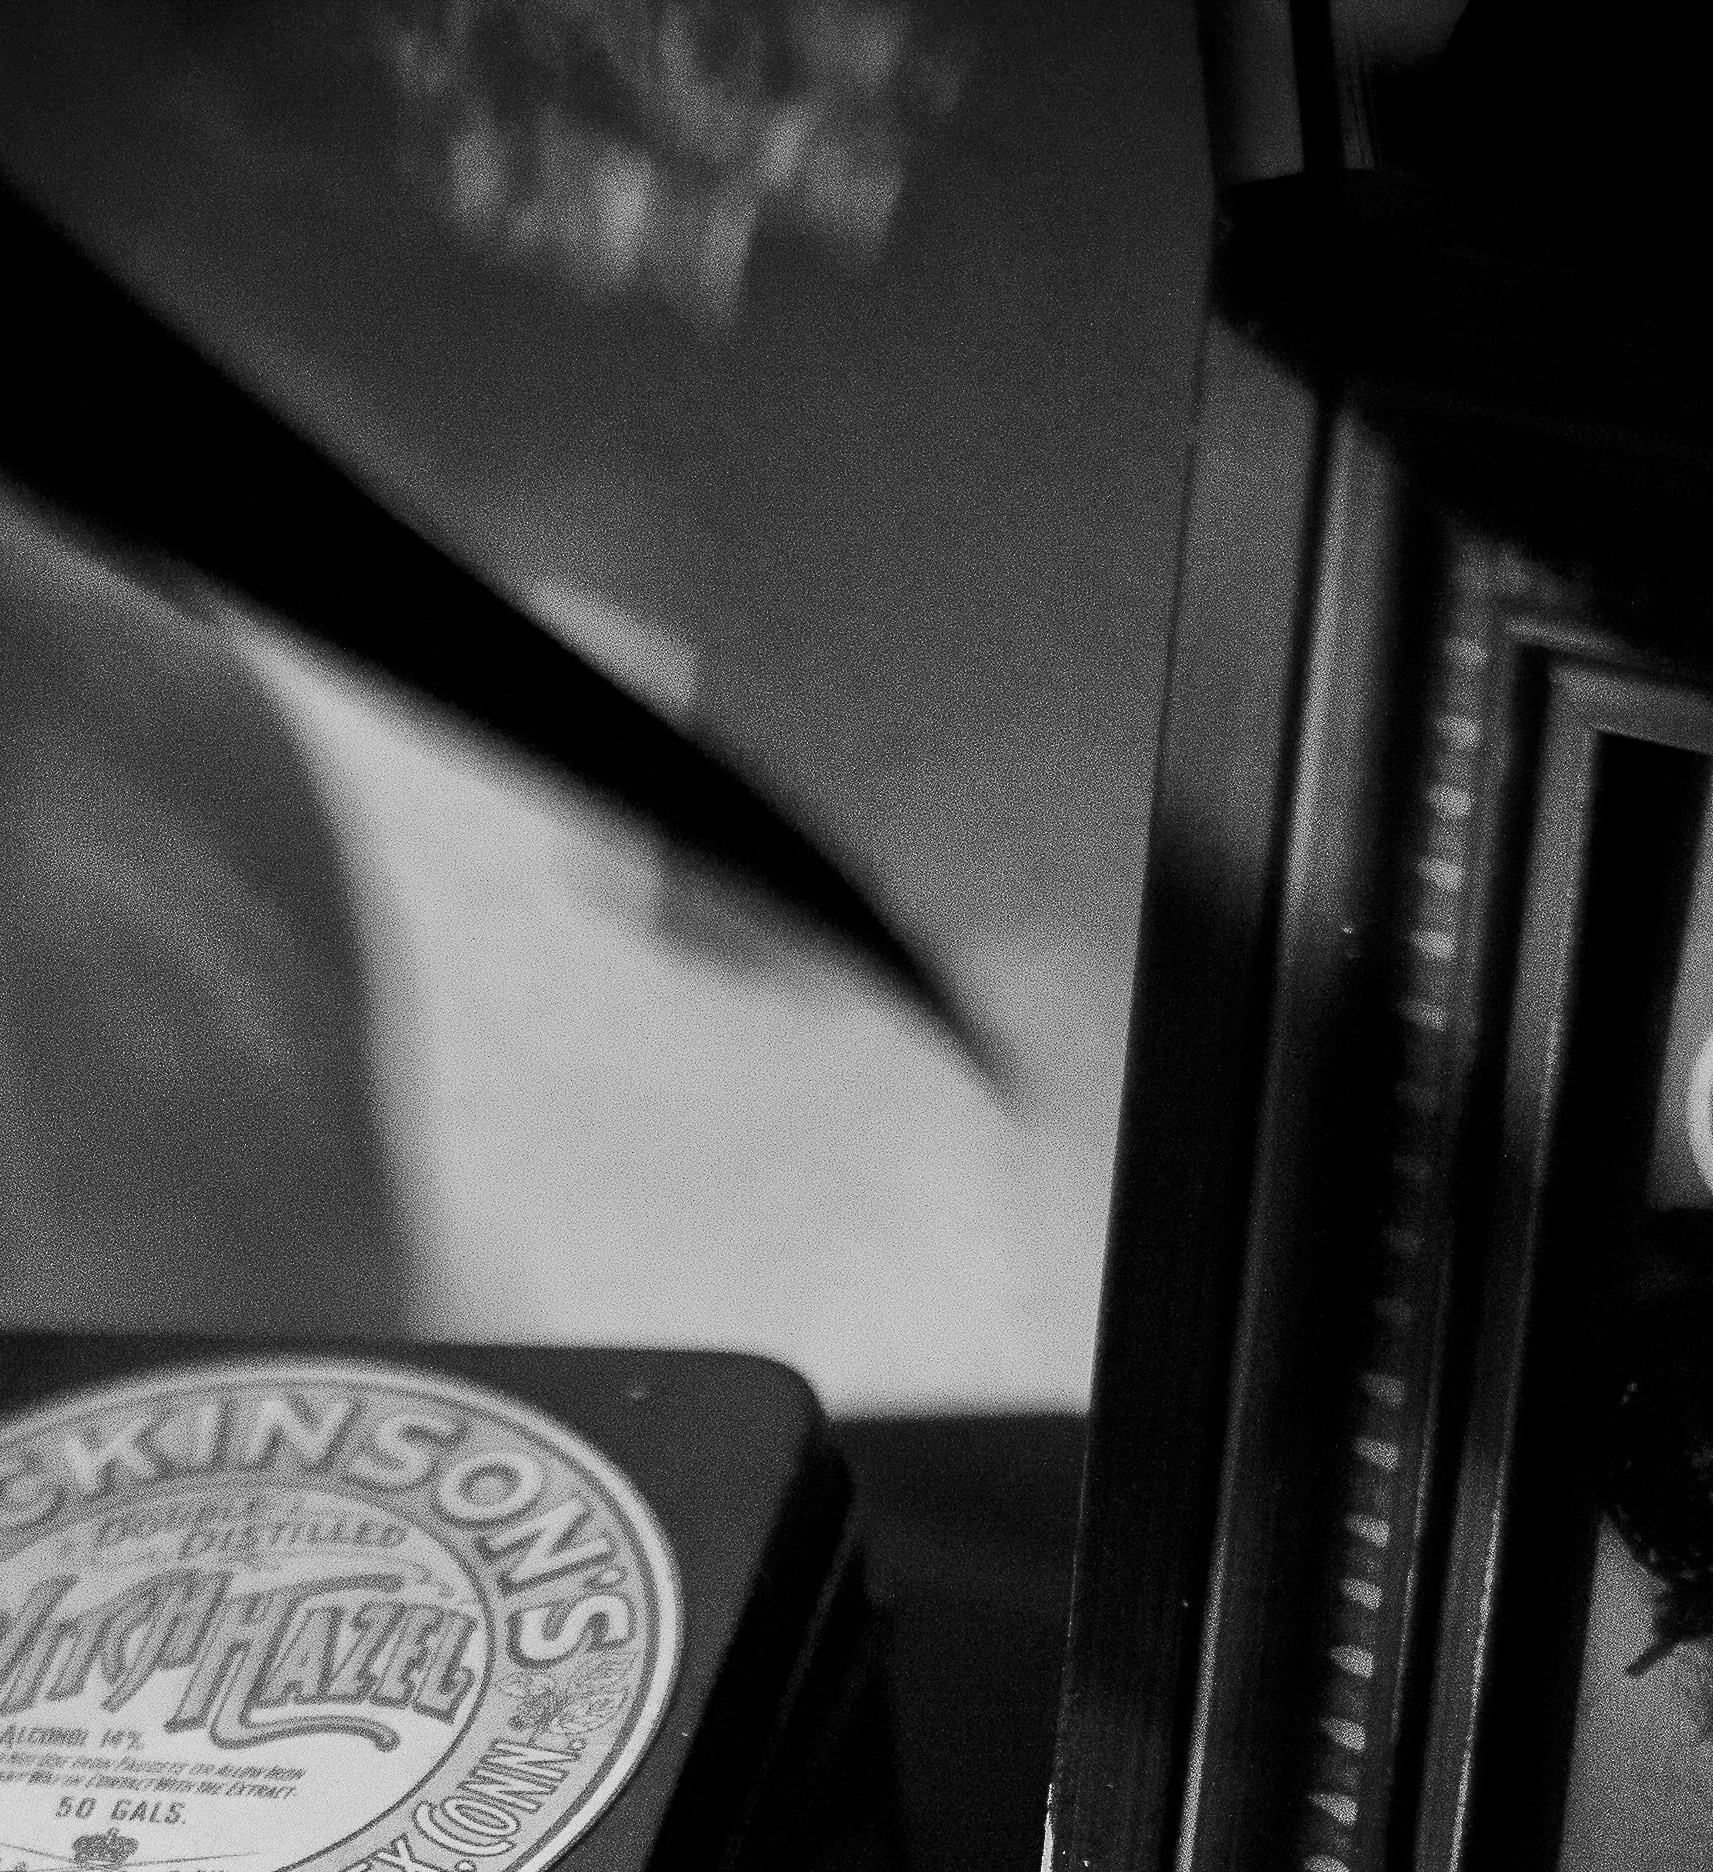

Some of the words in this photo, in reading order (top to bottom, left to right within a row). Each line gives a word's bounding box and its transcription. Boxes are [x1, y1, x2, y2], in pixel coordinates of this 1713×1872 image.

[176, 1520, 409, 1562] DISTILLED
[164, 1573, 477, 1752] HAZEL
[54, 1796, 97, 1820] 50
[110, 1798, 186, 1825] GALS.
